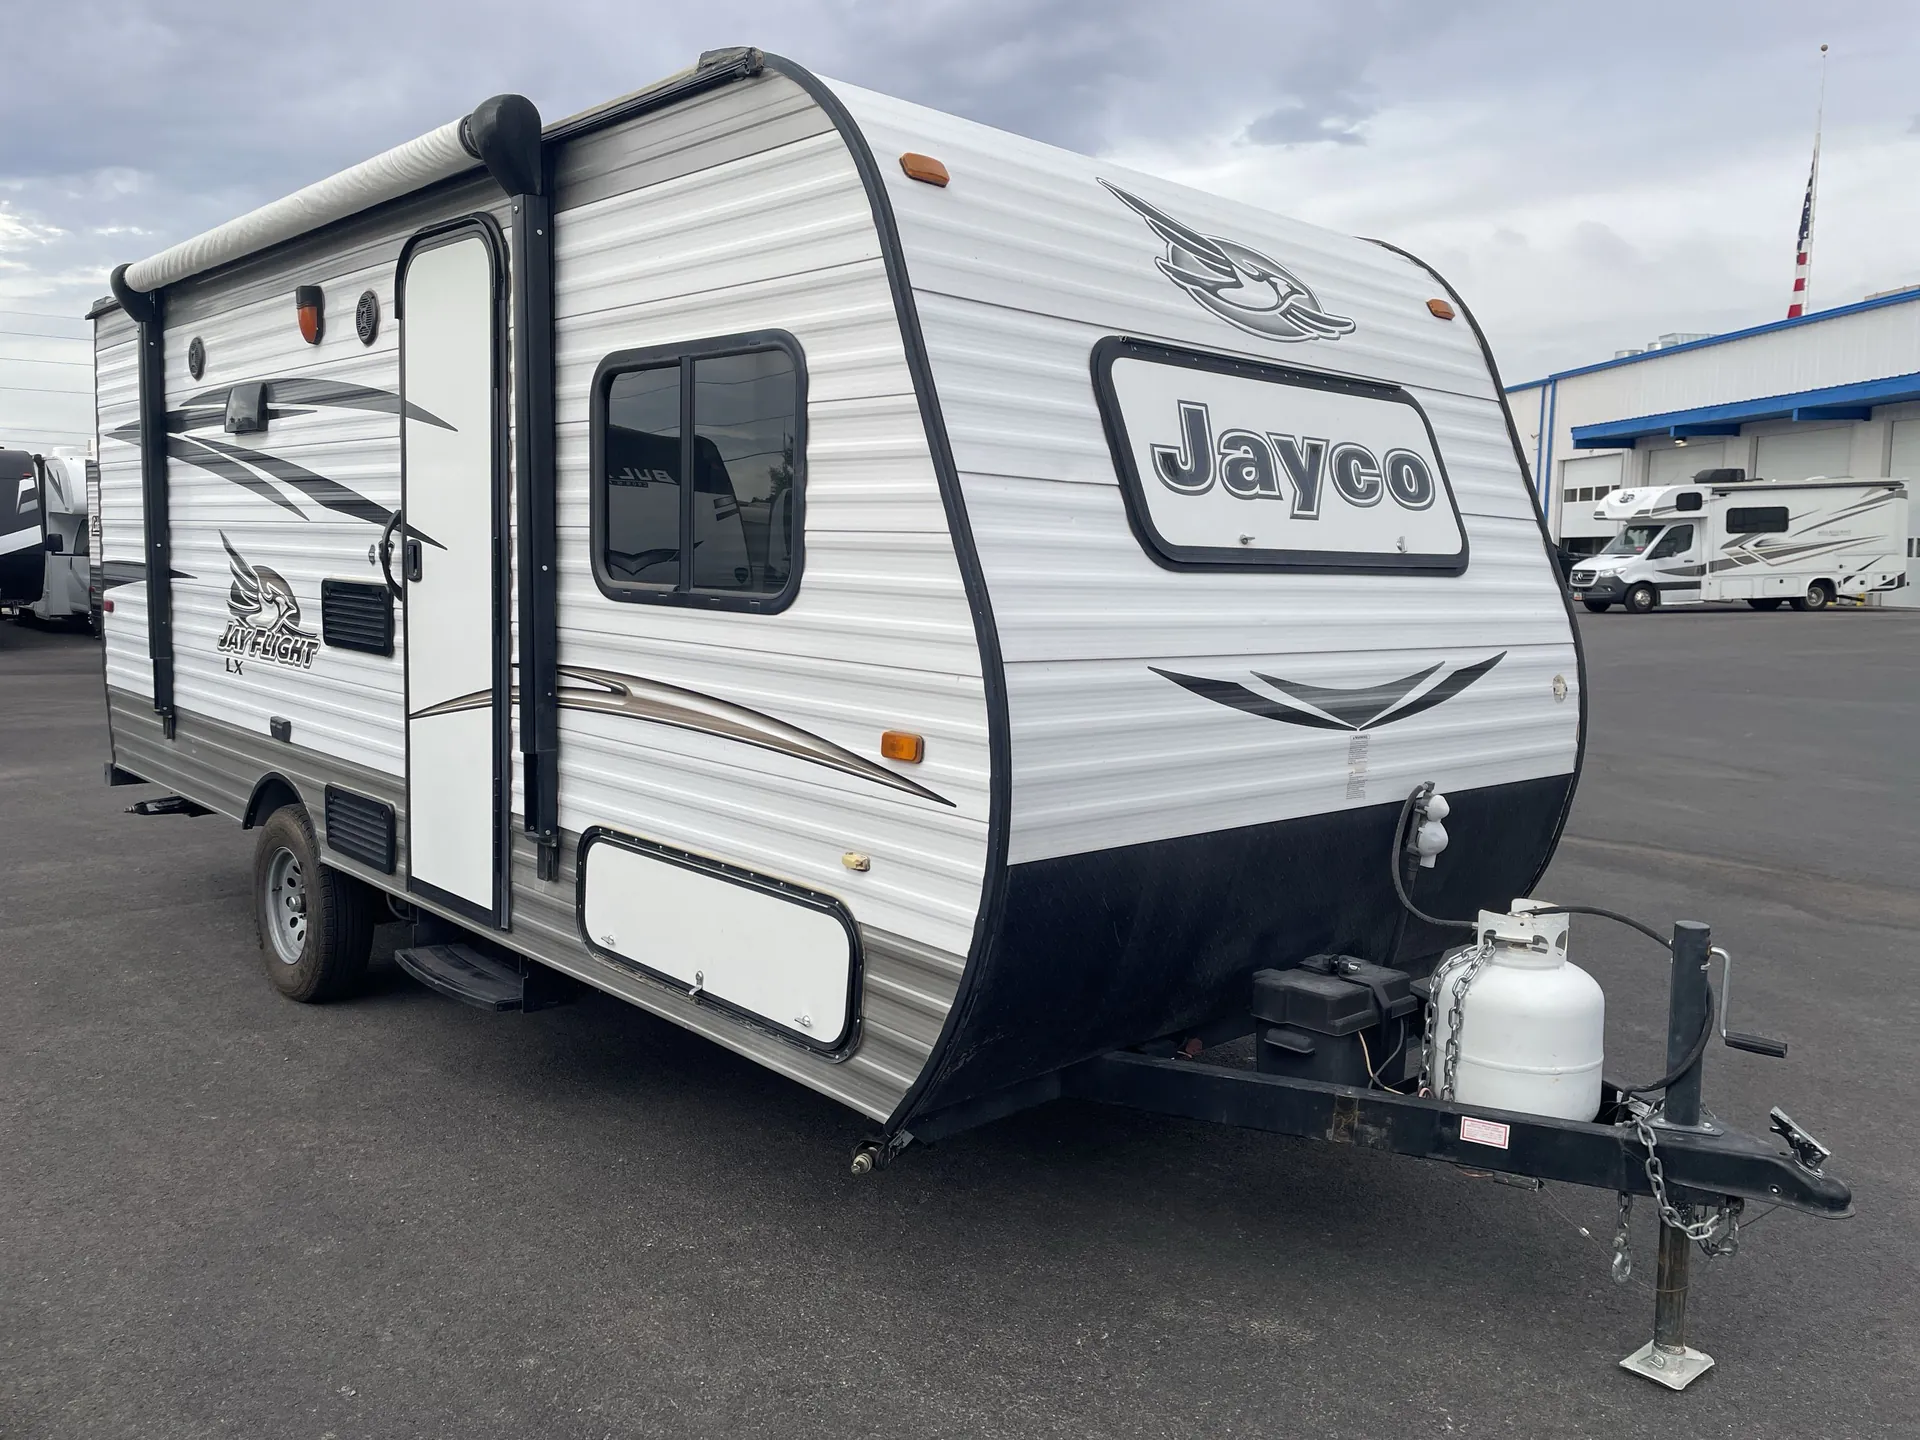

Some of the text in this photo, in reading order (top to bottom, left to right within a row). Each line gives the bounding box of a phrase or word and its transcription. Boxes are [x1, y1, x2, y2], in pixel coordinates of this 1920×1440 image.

[1150, 399, 1436, 521] Jayco
[217, 621, 321, 669] JAY FLIGHT
[225, 657, 243, 675] LX
